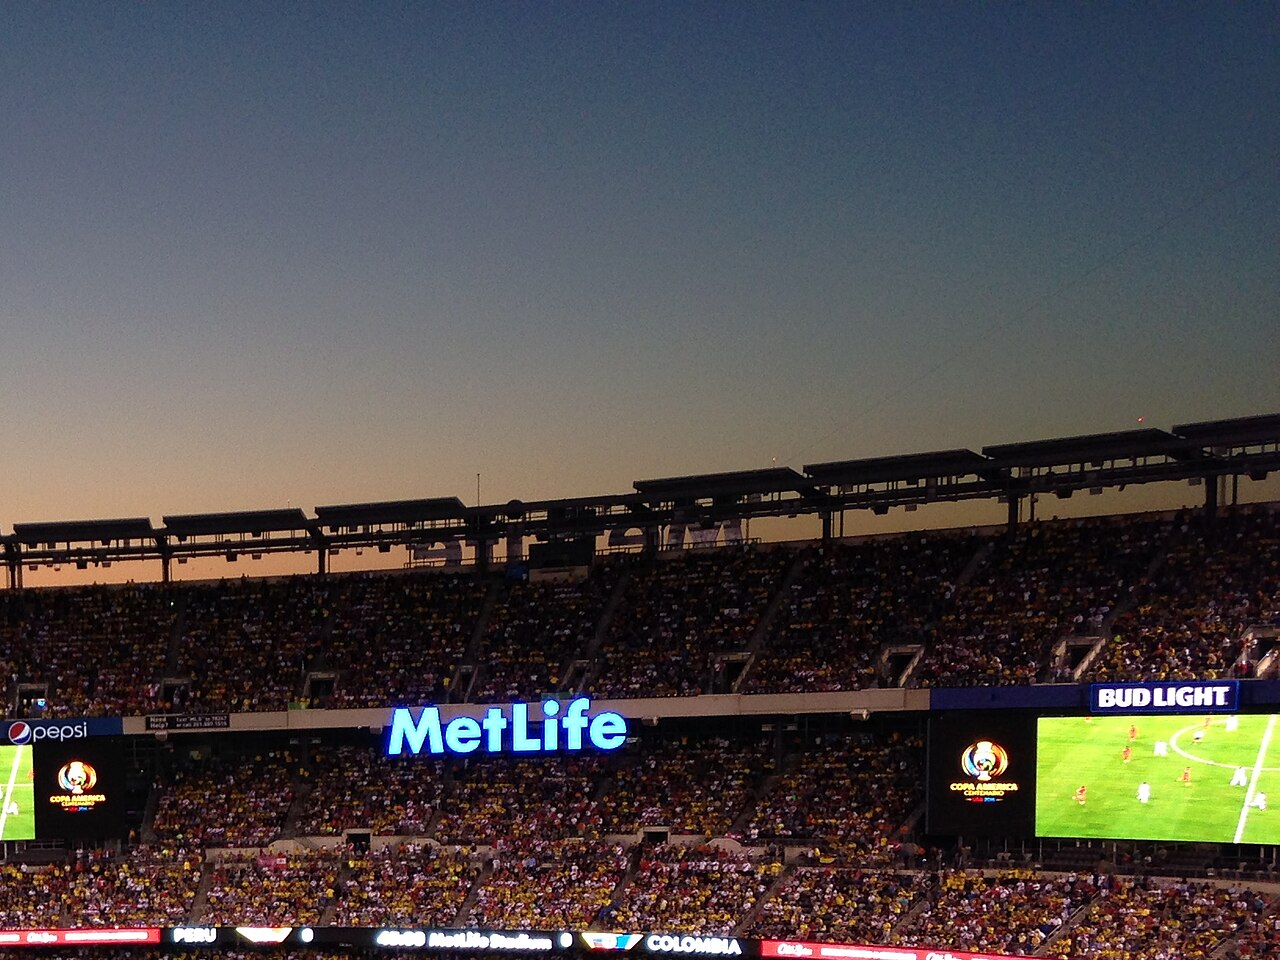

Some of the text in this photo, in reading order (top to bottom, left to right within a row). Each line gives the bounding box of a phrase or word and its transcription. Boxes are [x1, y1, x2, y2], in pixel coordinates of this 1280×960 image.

[1098, 686, 1231, 707] BUD LIGHT
[33, 722, 88, 742] pepsi
[388, 698, 627, 755] MetLife
[950, 783, 1018, 791] COPA AMERICA
[173, 927, 217, 943] PERU
[647, 935, 742, 955] COLOMBIA
